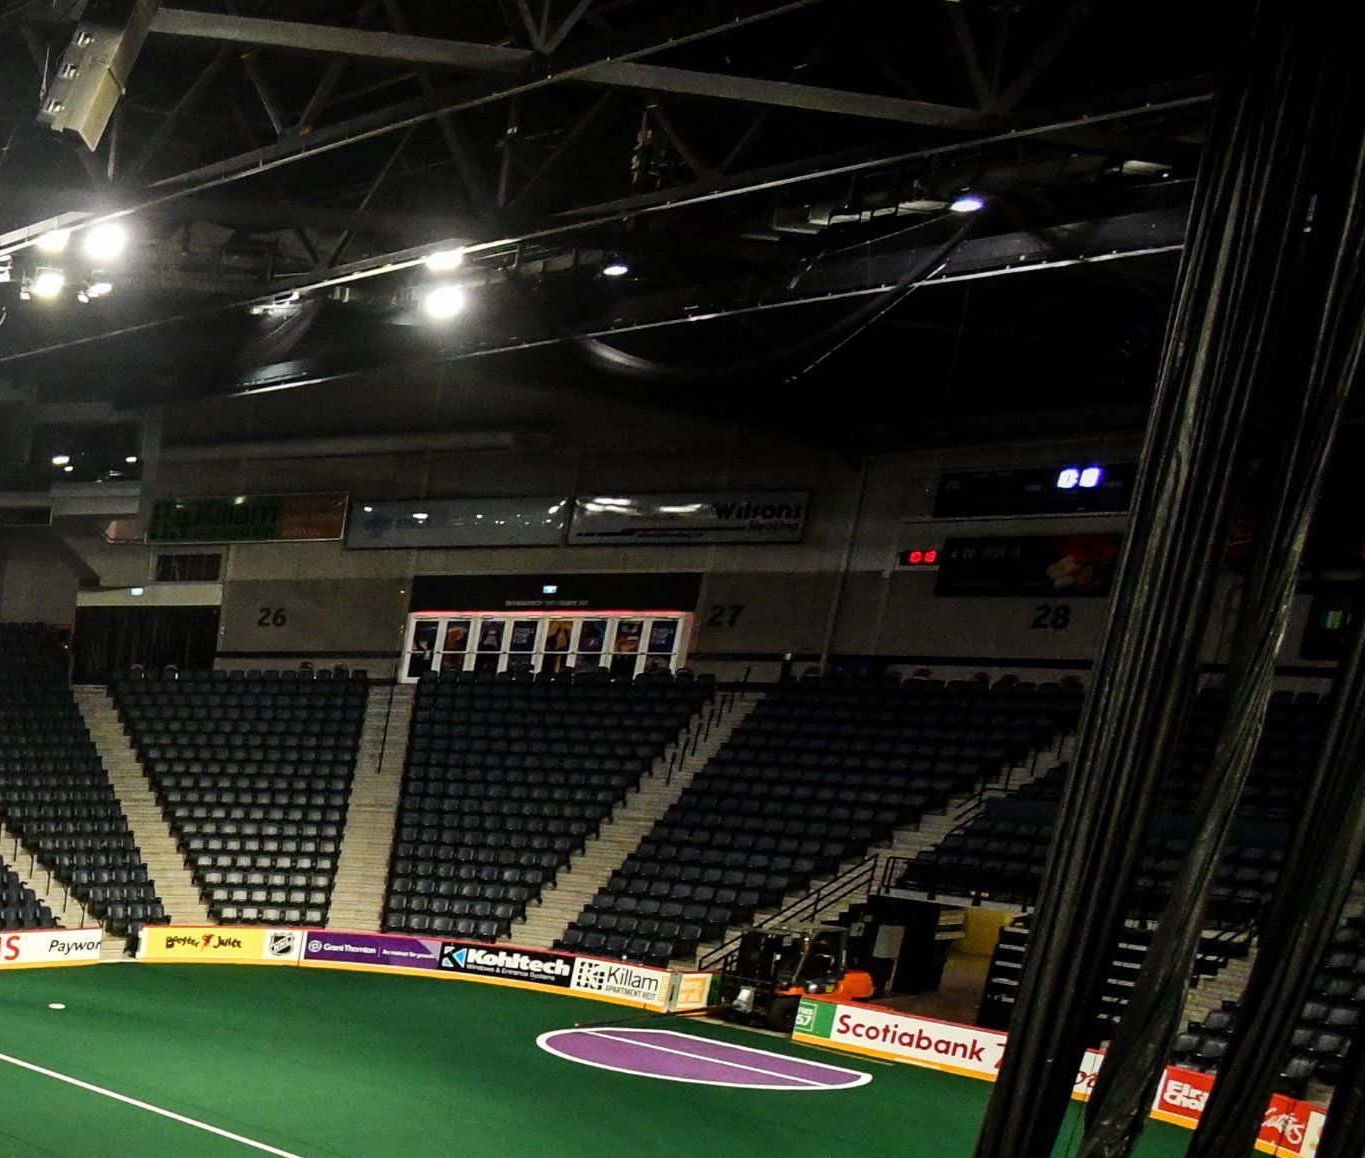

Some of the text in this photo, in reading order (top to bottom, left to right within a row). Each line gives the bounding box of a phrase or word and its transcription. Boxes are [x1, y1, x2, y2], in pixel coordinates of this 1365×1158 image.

[713, 502, 801, 520] Wilsons
[257, 607, 287, 627] 26
[708, 604, 743, 627] 27
[1031, 604, 1070, 629] 28
[212, 935, 242, 949] Juice
[322, 943, 376, 955] Grant Thornton
[466, 948, 571, 977] Kohltech
[607, 966, 659, 992] Killam
[604, 984, 641, 997] APARTMENT
[836, 1014, 986, 1063] Scotiabank
